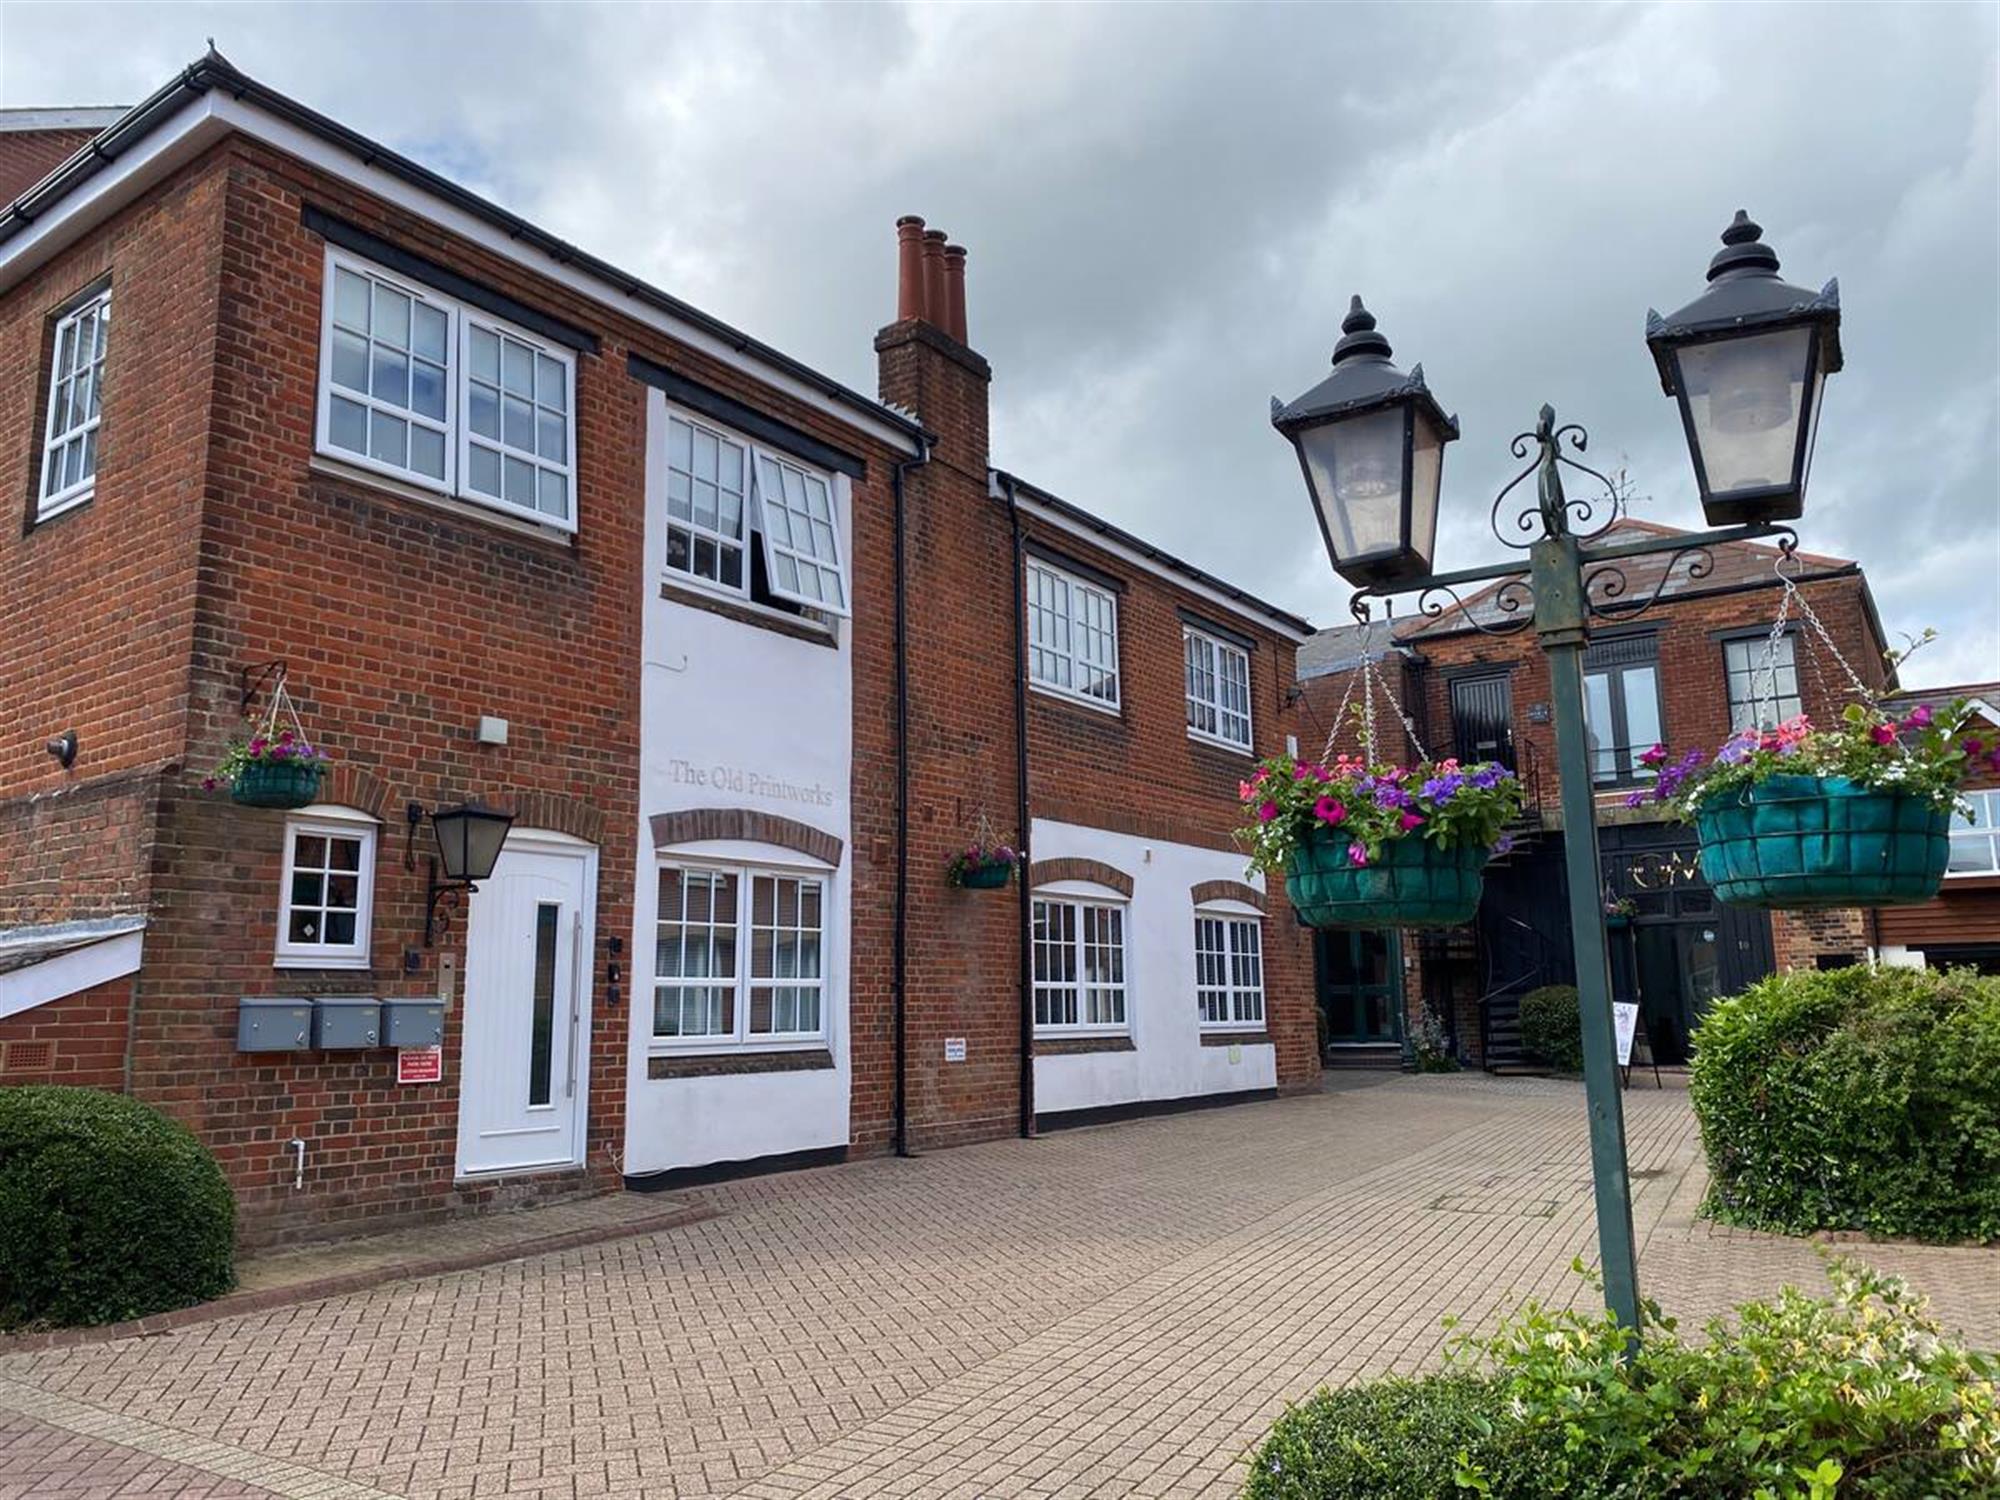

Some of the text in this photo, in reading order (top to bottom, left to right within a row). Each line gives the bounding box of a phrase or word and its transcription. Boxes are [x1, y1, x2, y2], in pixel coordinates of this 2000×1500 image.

[670, 759, 833, 806] The Old Printworks
